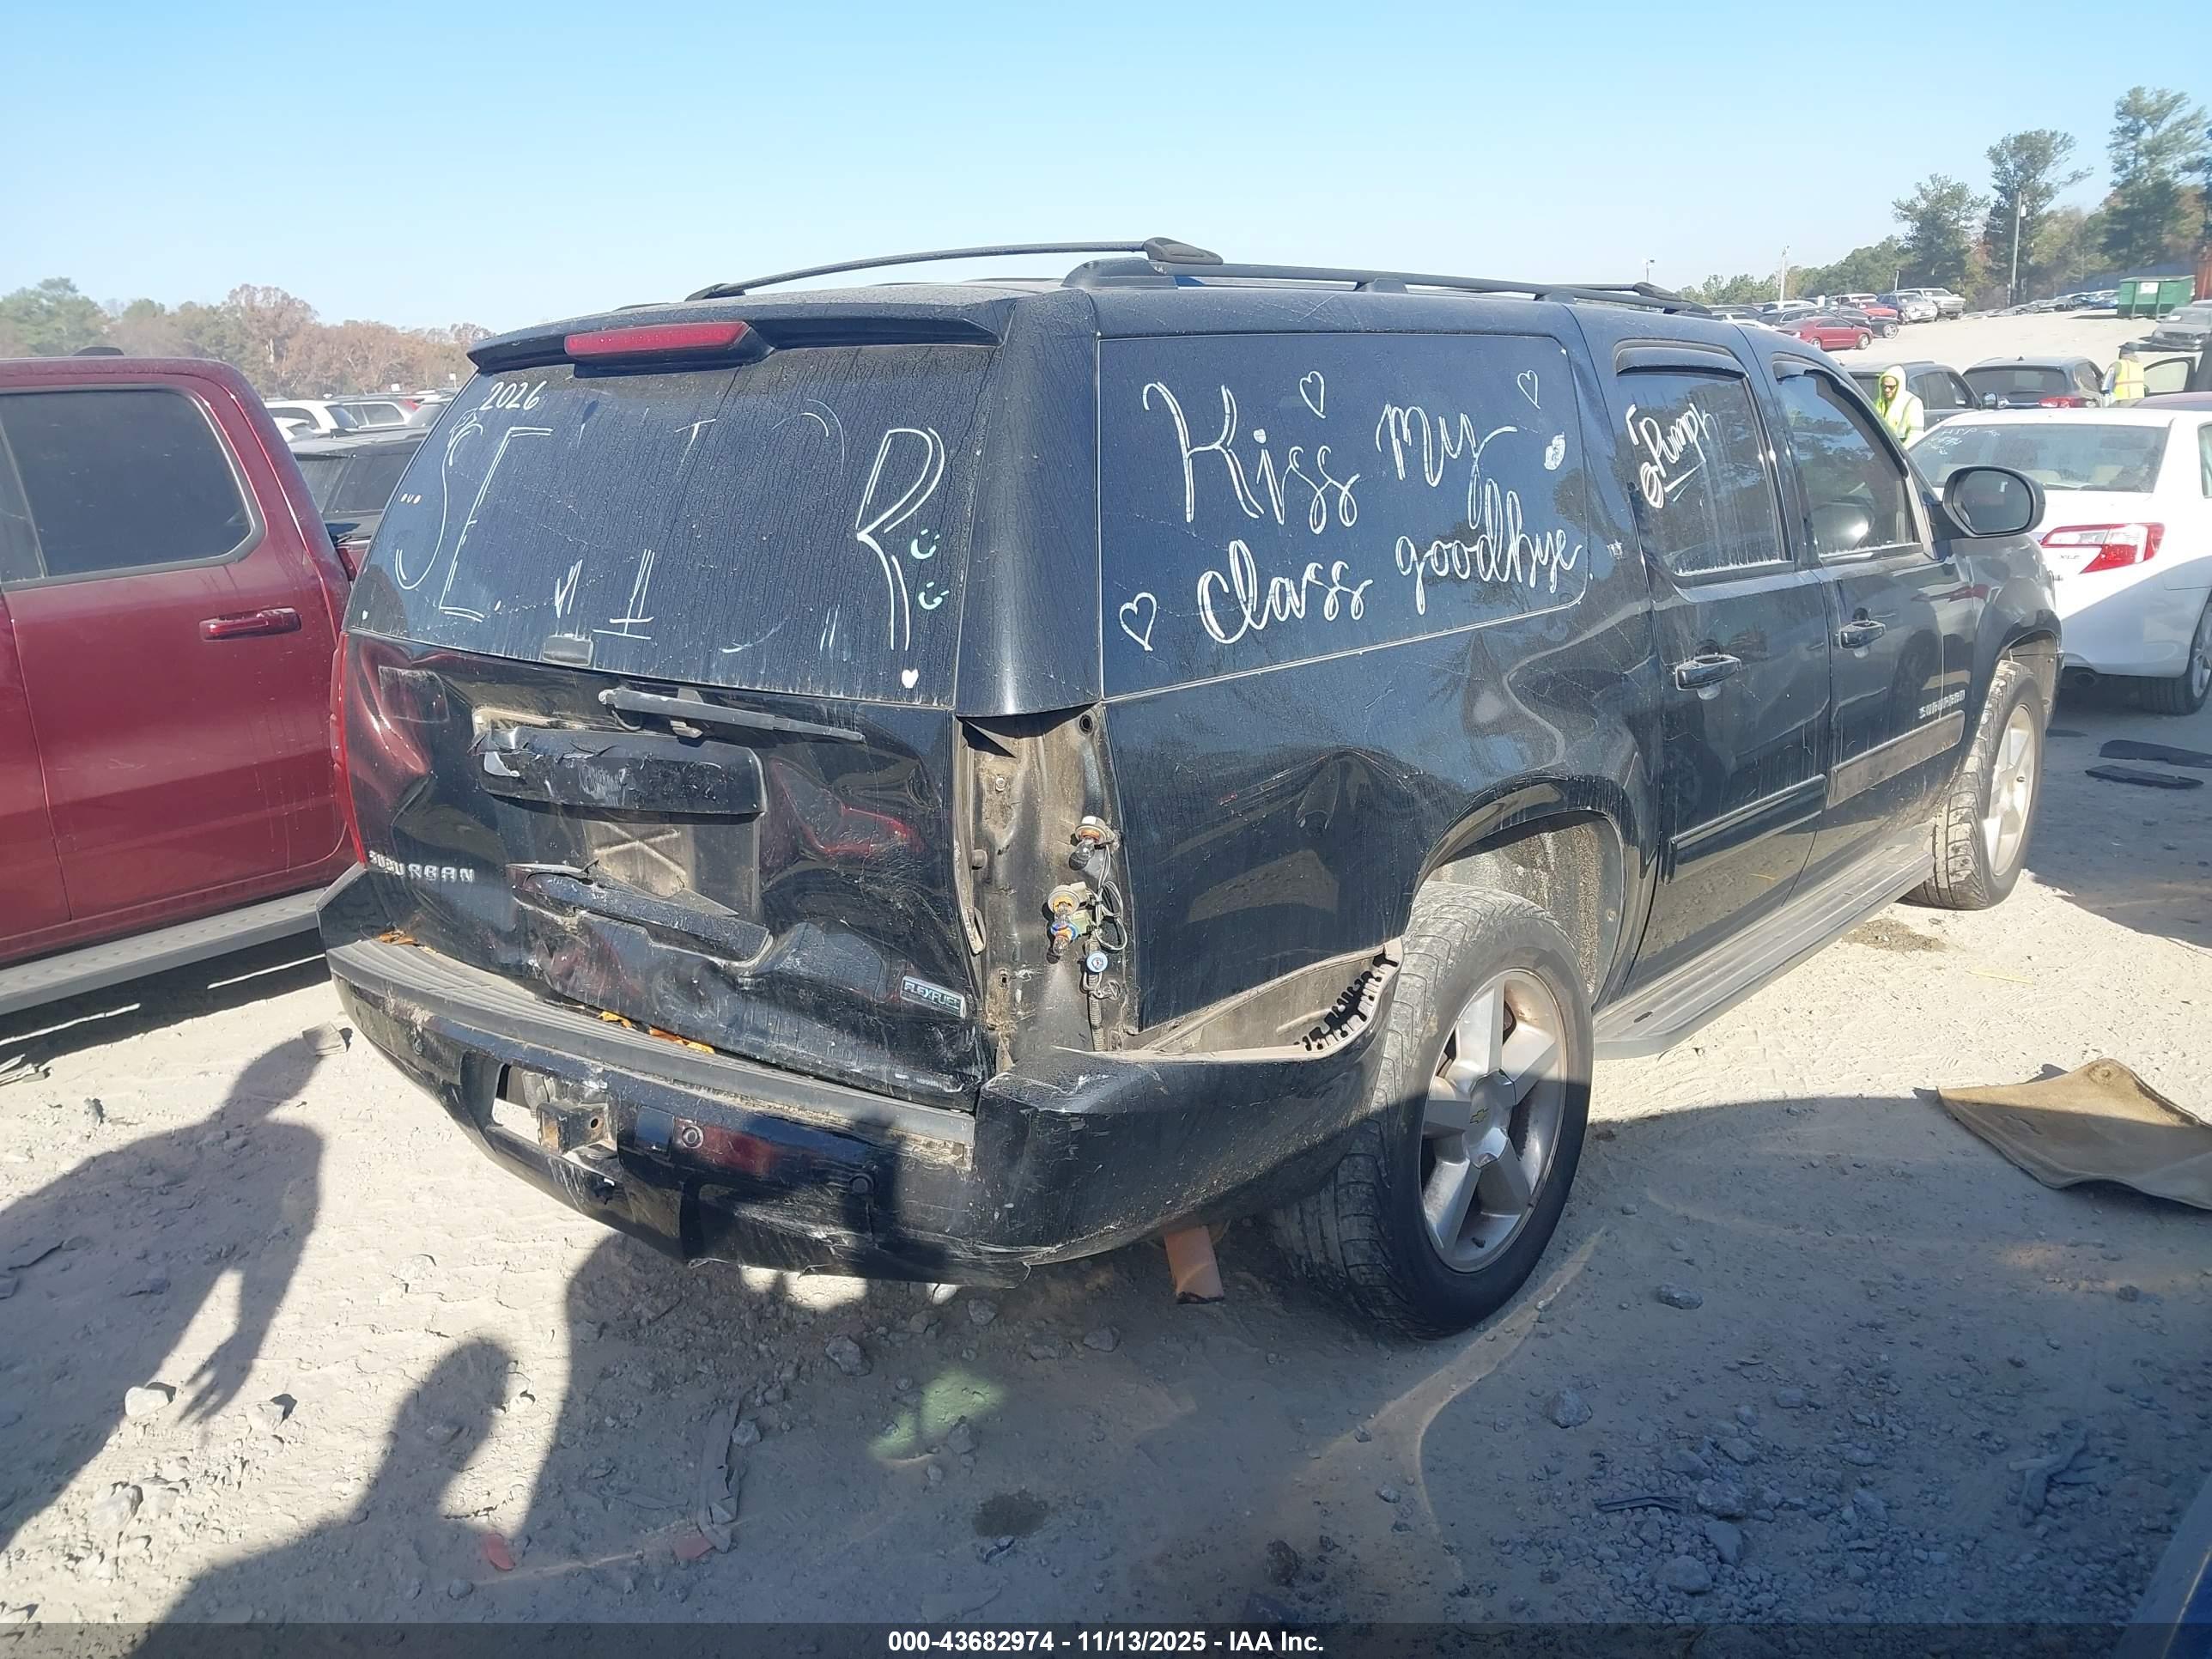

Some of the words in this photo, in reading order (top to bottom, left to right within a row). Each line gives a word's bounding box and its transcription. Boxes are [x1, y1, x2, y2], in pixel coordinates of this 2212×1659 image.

[479, 381, 547, 410] 2026
[1143, 382, 1360, 534] Kiss
[368, 849, 474, 884] SUBURBAN
